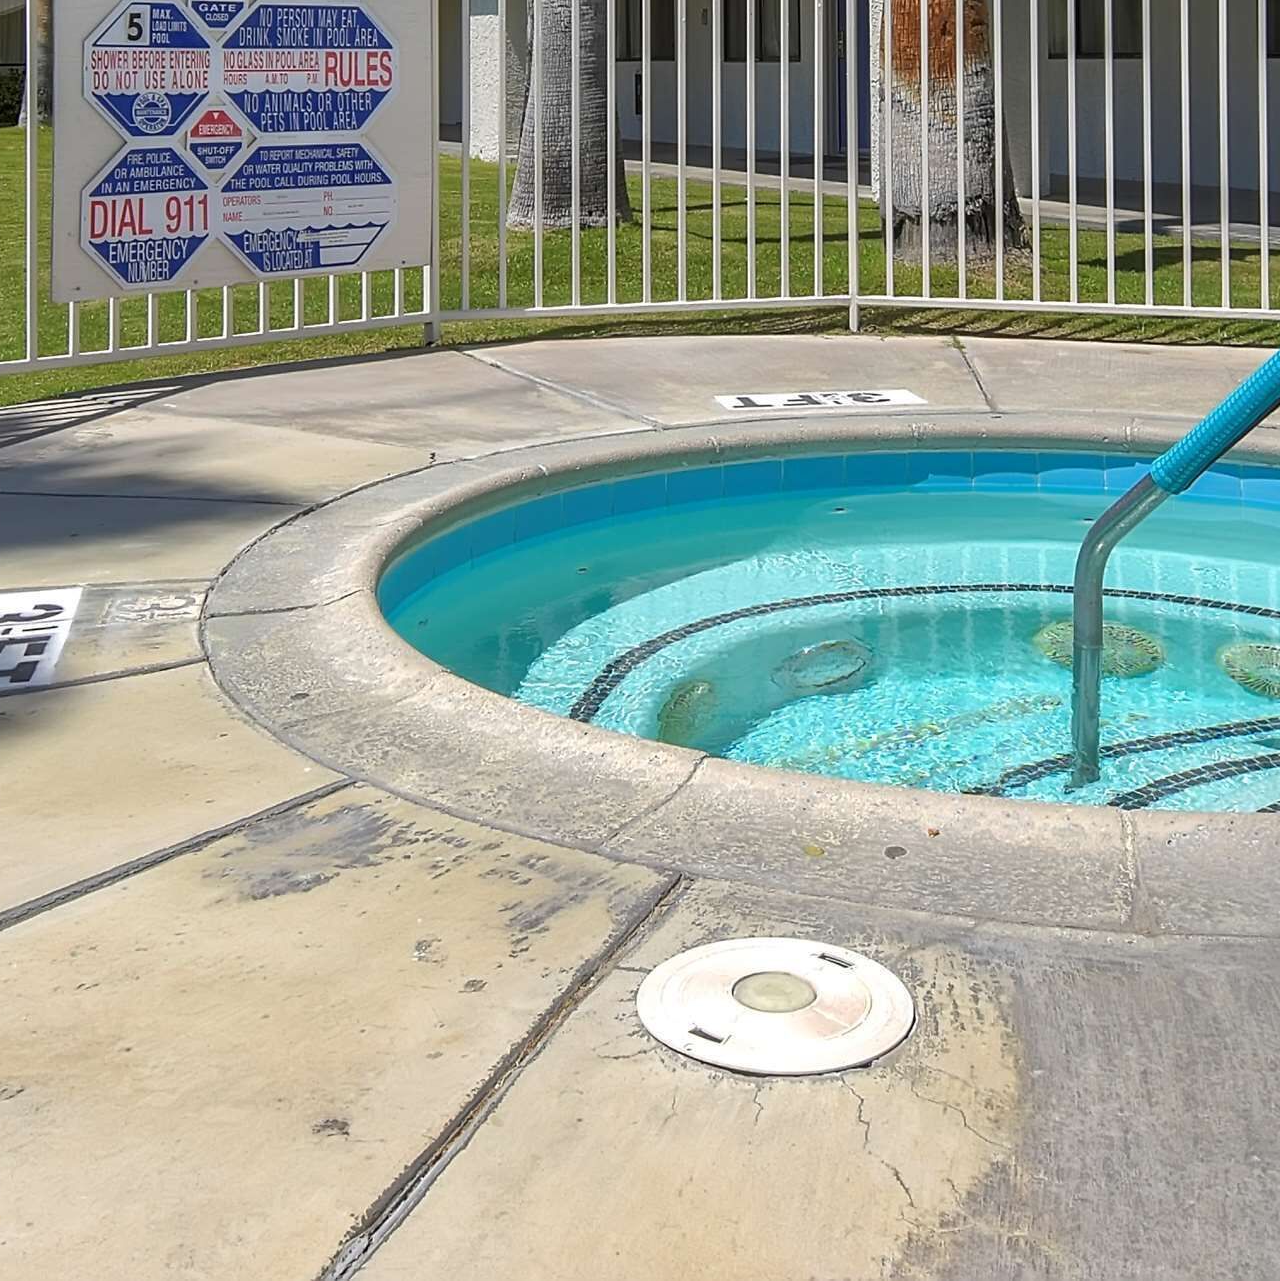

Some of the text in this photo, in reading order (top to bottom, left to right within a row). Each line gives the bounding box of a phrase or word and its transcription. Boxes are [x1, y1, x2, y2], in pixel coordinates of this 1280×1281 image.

[152, 9, 174, 19] MAX.
[199, 4, 236, 12] GATE
[206, 13, 229, 21] CLOSED
[260, 8, 272, 27] NO
[277, 8, 314, 28] PERSON
[319, 9, 338, 28] MAY
[127, 12, 143, 41] 5
[152, 21, 188, 32] LOAD LIMITS
[152, 33, 170, 44] POOL
[276, 28, 309, 47] SMOKE
[313, 28, 322, 47] IN
[326, 28, 351, 47] POOL
[355, 28, 379, 47] AREA
[91, 50, 210, 69] SHOWER BEFORE ENTERING
[224, 52, 319, 69] NO GLASS IN POOL AREA
[325, 51, 393, 87] RULES
[93, 70, 208, 90] DO NOT USE ALONE
[224, 73, 248, 85] HOURS
[280, 73, 288, 84] TO
[244, 92, 372, 113] NO ANIMALS OR OTHER
[199, 124, 233, 135] EMERGENCY
[261, 111, 358, 132] PETS IN POOL AREA
[197, 146, 235, 156] SHUT-OFF
[260, 150, 269, 161] TO
[270, 149, 294, 161] REPORT
[336, 147, 359, 158] SAFETY
[205, 156, 226, 164] SWITCH
[243, 160, 373, 176] OR WATER QUALITY PROBLEMS WITH
[114, 165, 185, 179] OR AMBULANCE
[101, 178, 196, 194] IN AN EMERGENCY
[231, 172, 384, 190] THE POOL CALL DURING POOL HOURS.
[222, 195, 261, 207] OPERATORS
[90, 194, 208, 239] DIAL 911
[223, 212, 243, 222] NAME
[244, 231, 297, 253] EMERGENCY
[109, 239, 189, 264] EMERGENCY
[263, 249, 313, 271] IS LOCATED AT
[128, 260, 170, 282] NUMBER
